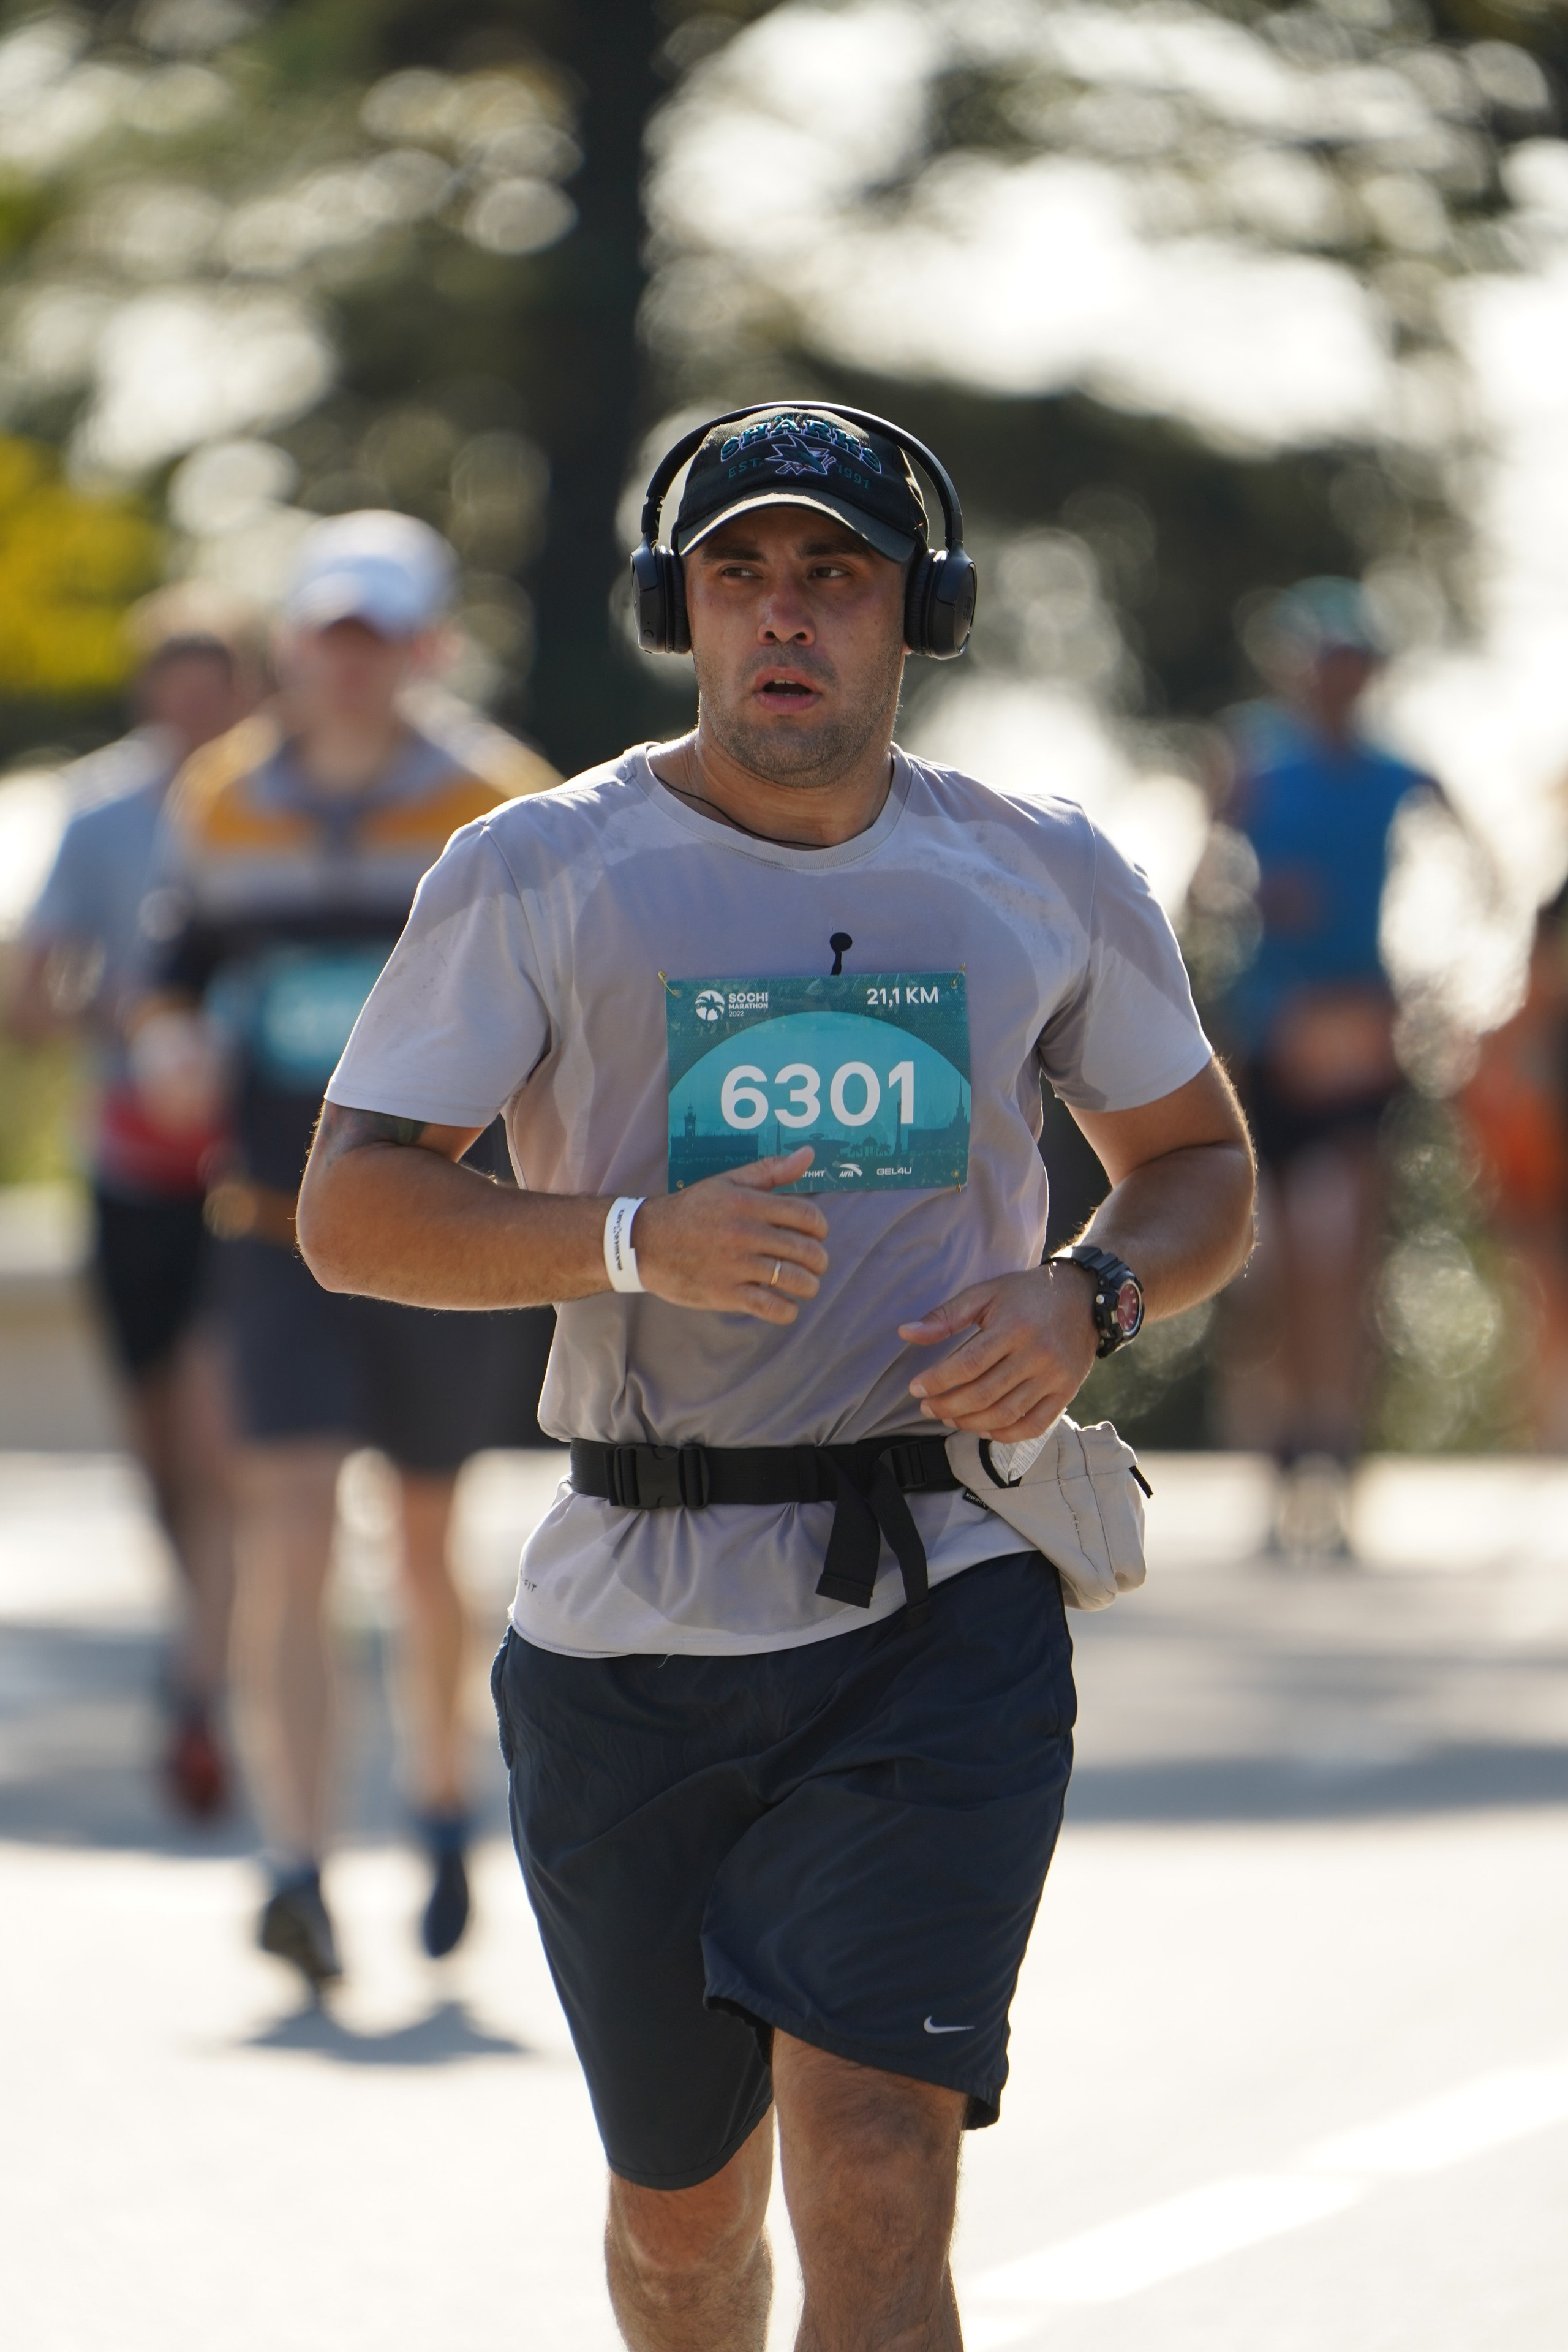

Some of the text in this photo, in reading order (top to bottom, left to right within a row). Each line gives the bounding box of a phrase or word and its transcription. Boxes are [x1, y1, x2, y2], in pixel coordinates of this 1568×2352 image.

[720, 419, 882, 474] SHARKS
[837, 464, 870, 489] 1991
[728, 992, 768, 1003] SOCHI
[866, 986, 939, 1007] 21,1 KM
[721, 1061, 914, 1129] 6301
[876, 1167, 912, 1176] GEL4U
